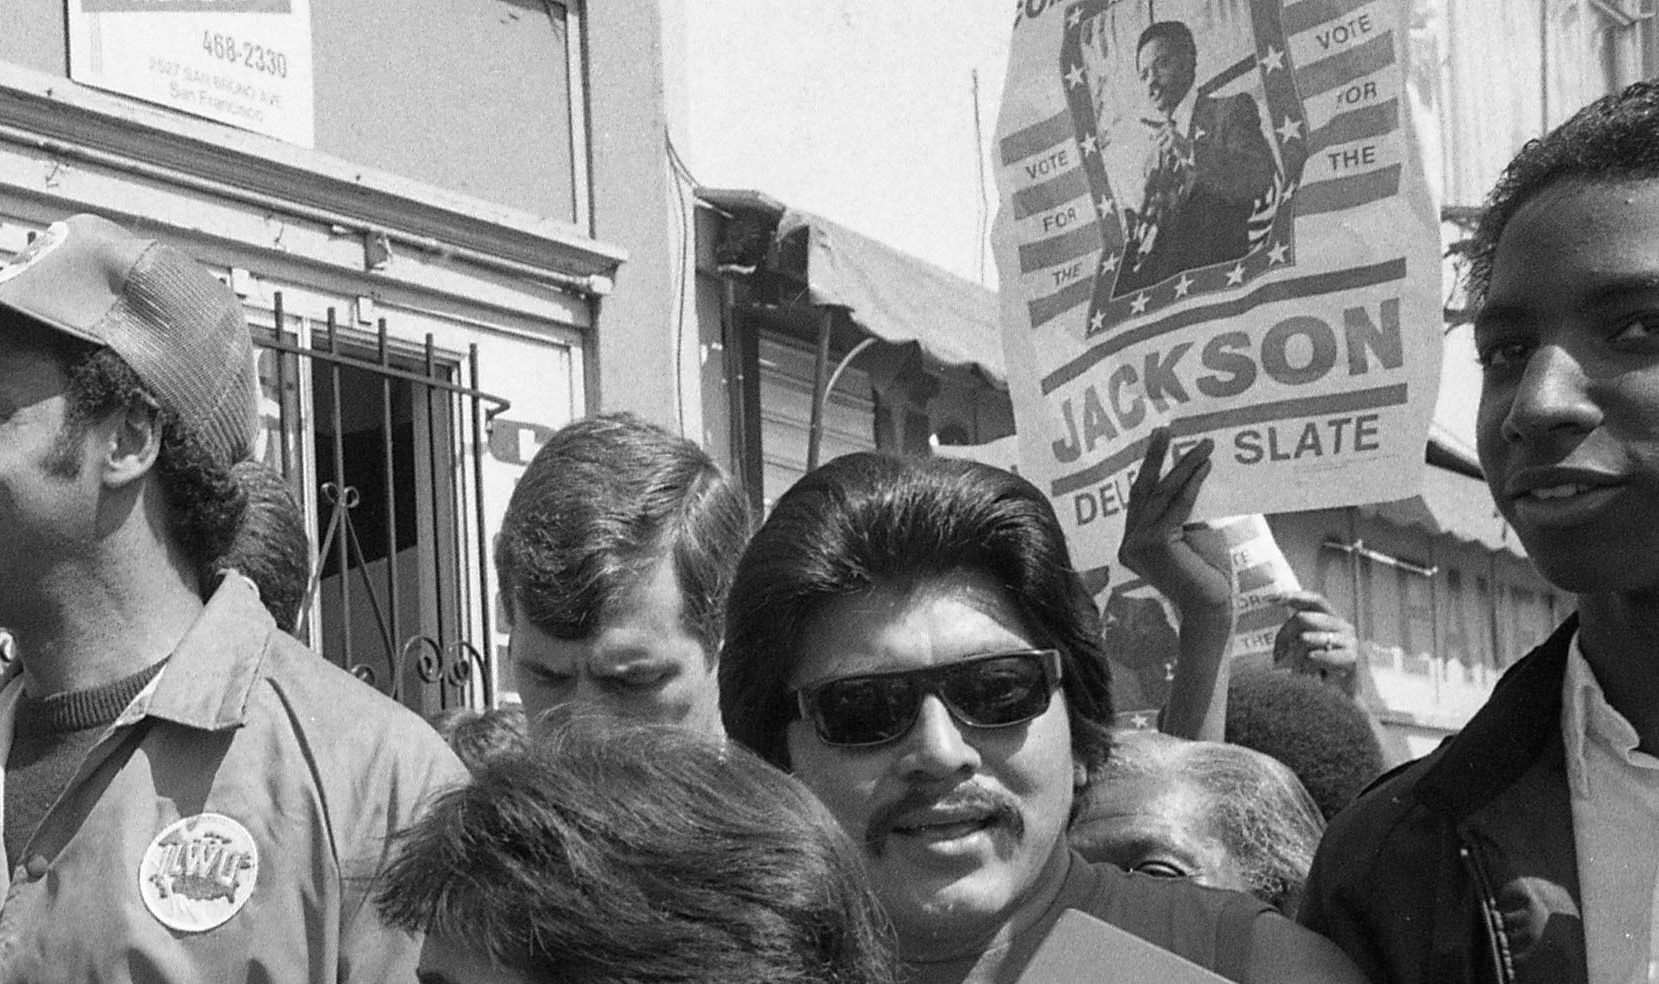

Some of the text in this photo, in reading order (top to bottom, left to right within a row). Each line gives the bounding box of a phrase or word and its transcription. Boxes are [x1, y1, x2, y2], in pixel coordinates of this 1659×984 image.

[1315, 14, 1372, 50] VOTE
[202, 30, 287, 78] 468-2330
[169, 81, 196, 103] San
[1025, 150, 1069, 179] VOTE
[1328, 146, 1376, 170] THE
[1042, 207, 1078, 232] FOR
[1052, 262, 1083, 286] THE
[1052, 299, 1404, 464] JACKSON
[1234, 414, 1380, 465] SLATE
